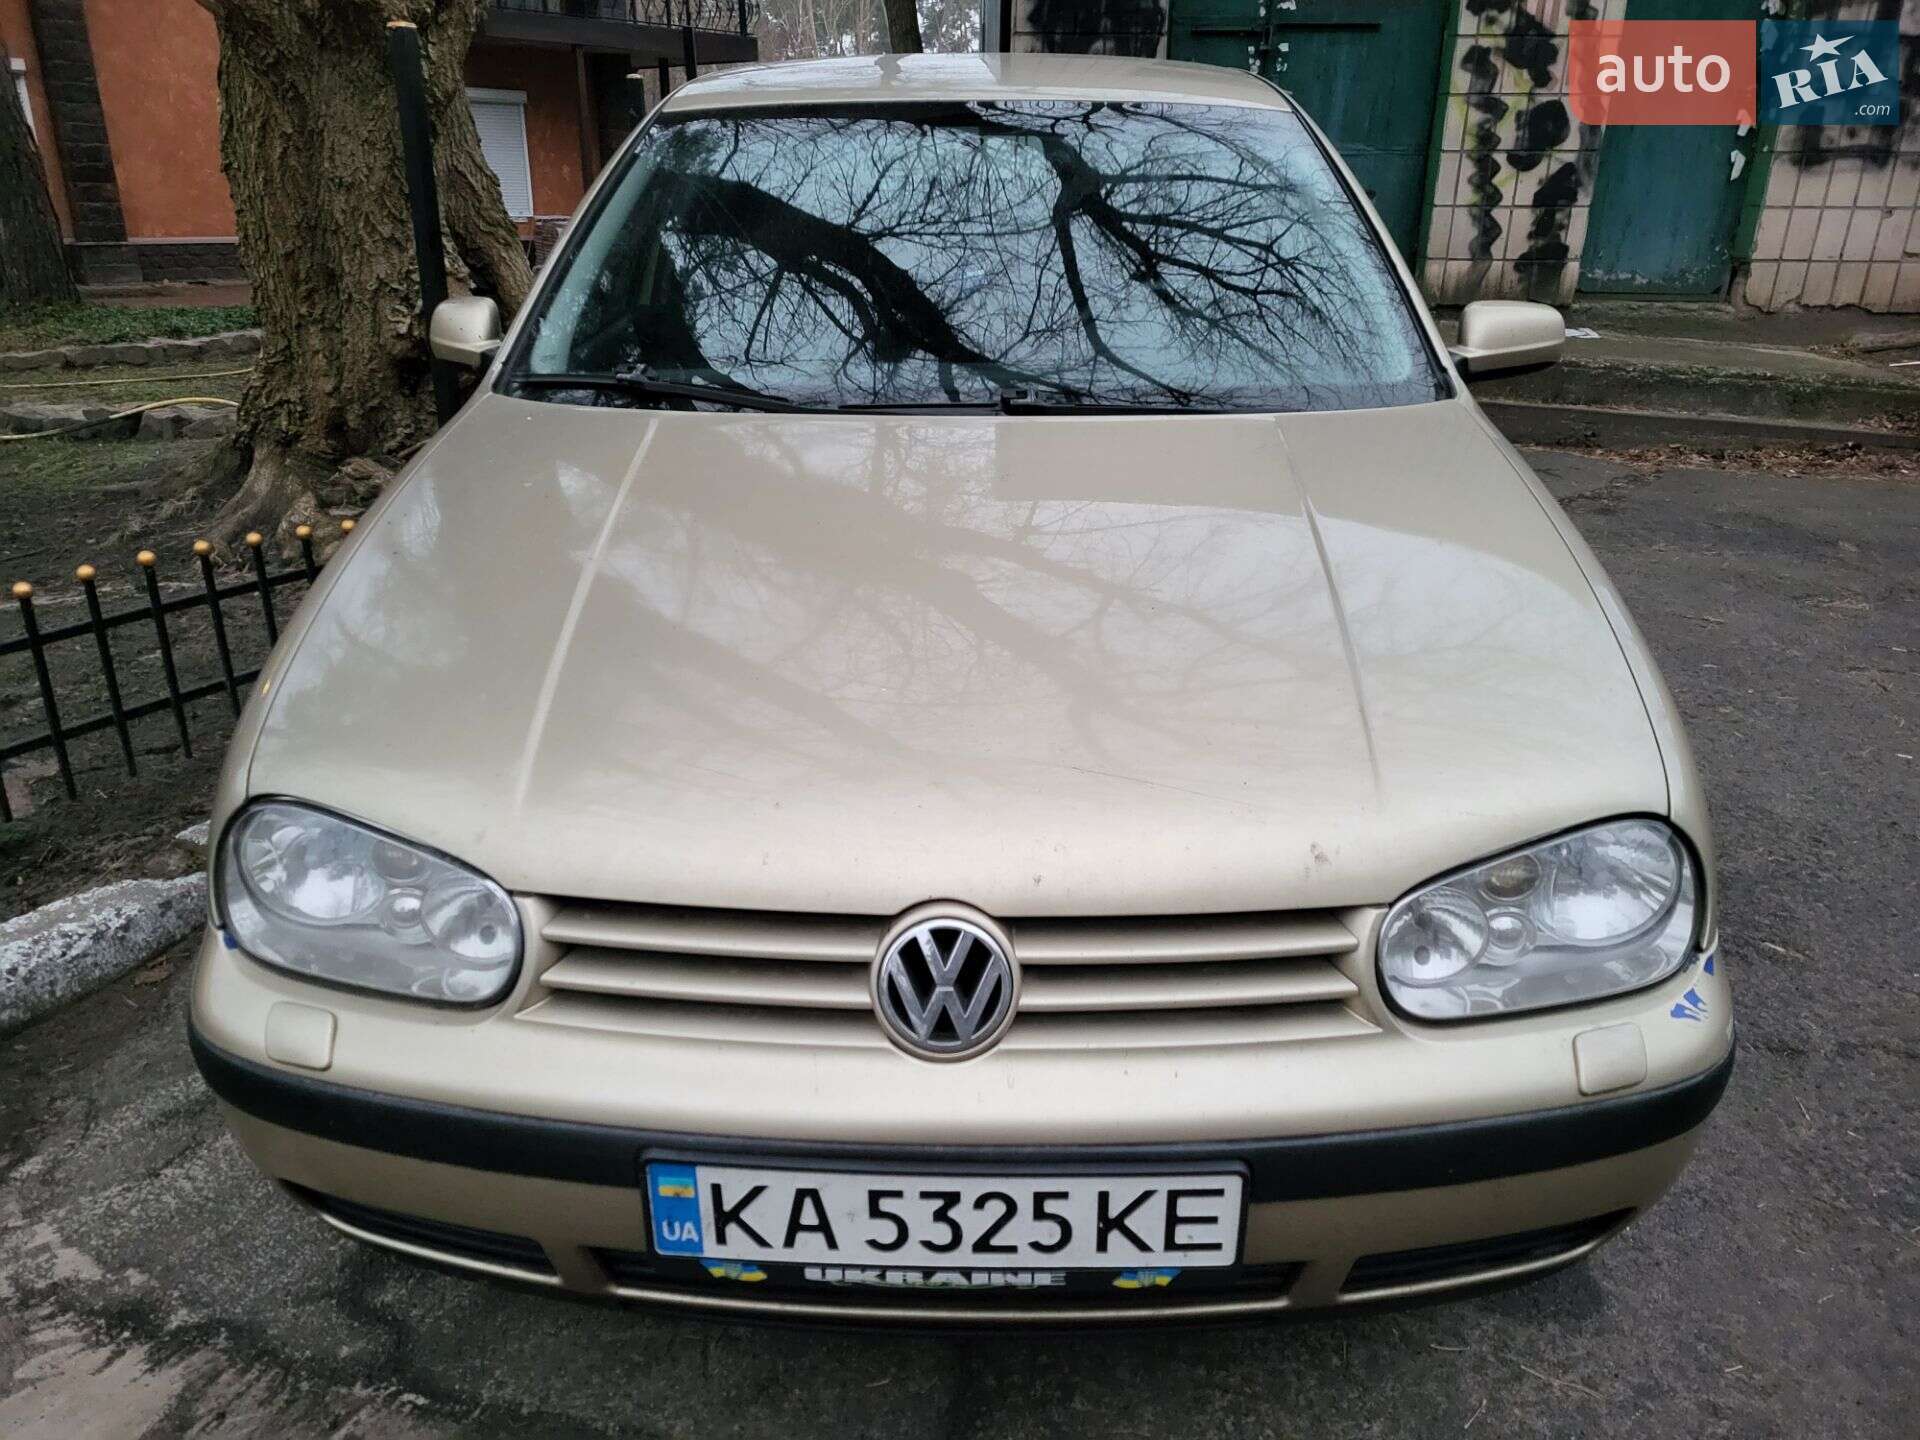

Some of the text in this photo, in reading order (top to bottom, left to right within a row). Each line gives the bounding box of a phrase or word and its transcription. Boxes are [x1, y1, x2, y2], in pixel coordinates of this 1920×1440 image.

[661, 1219, 699, 1244] UA
[710, 1183, 1225, 1255] KA 5325 KE
[804, 1265, 1067, 1289] UKRAINE
